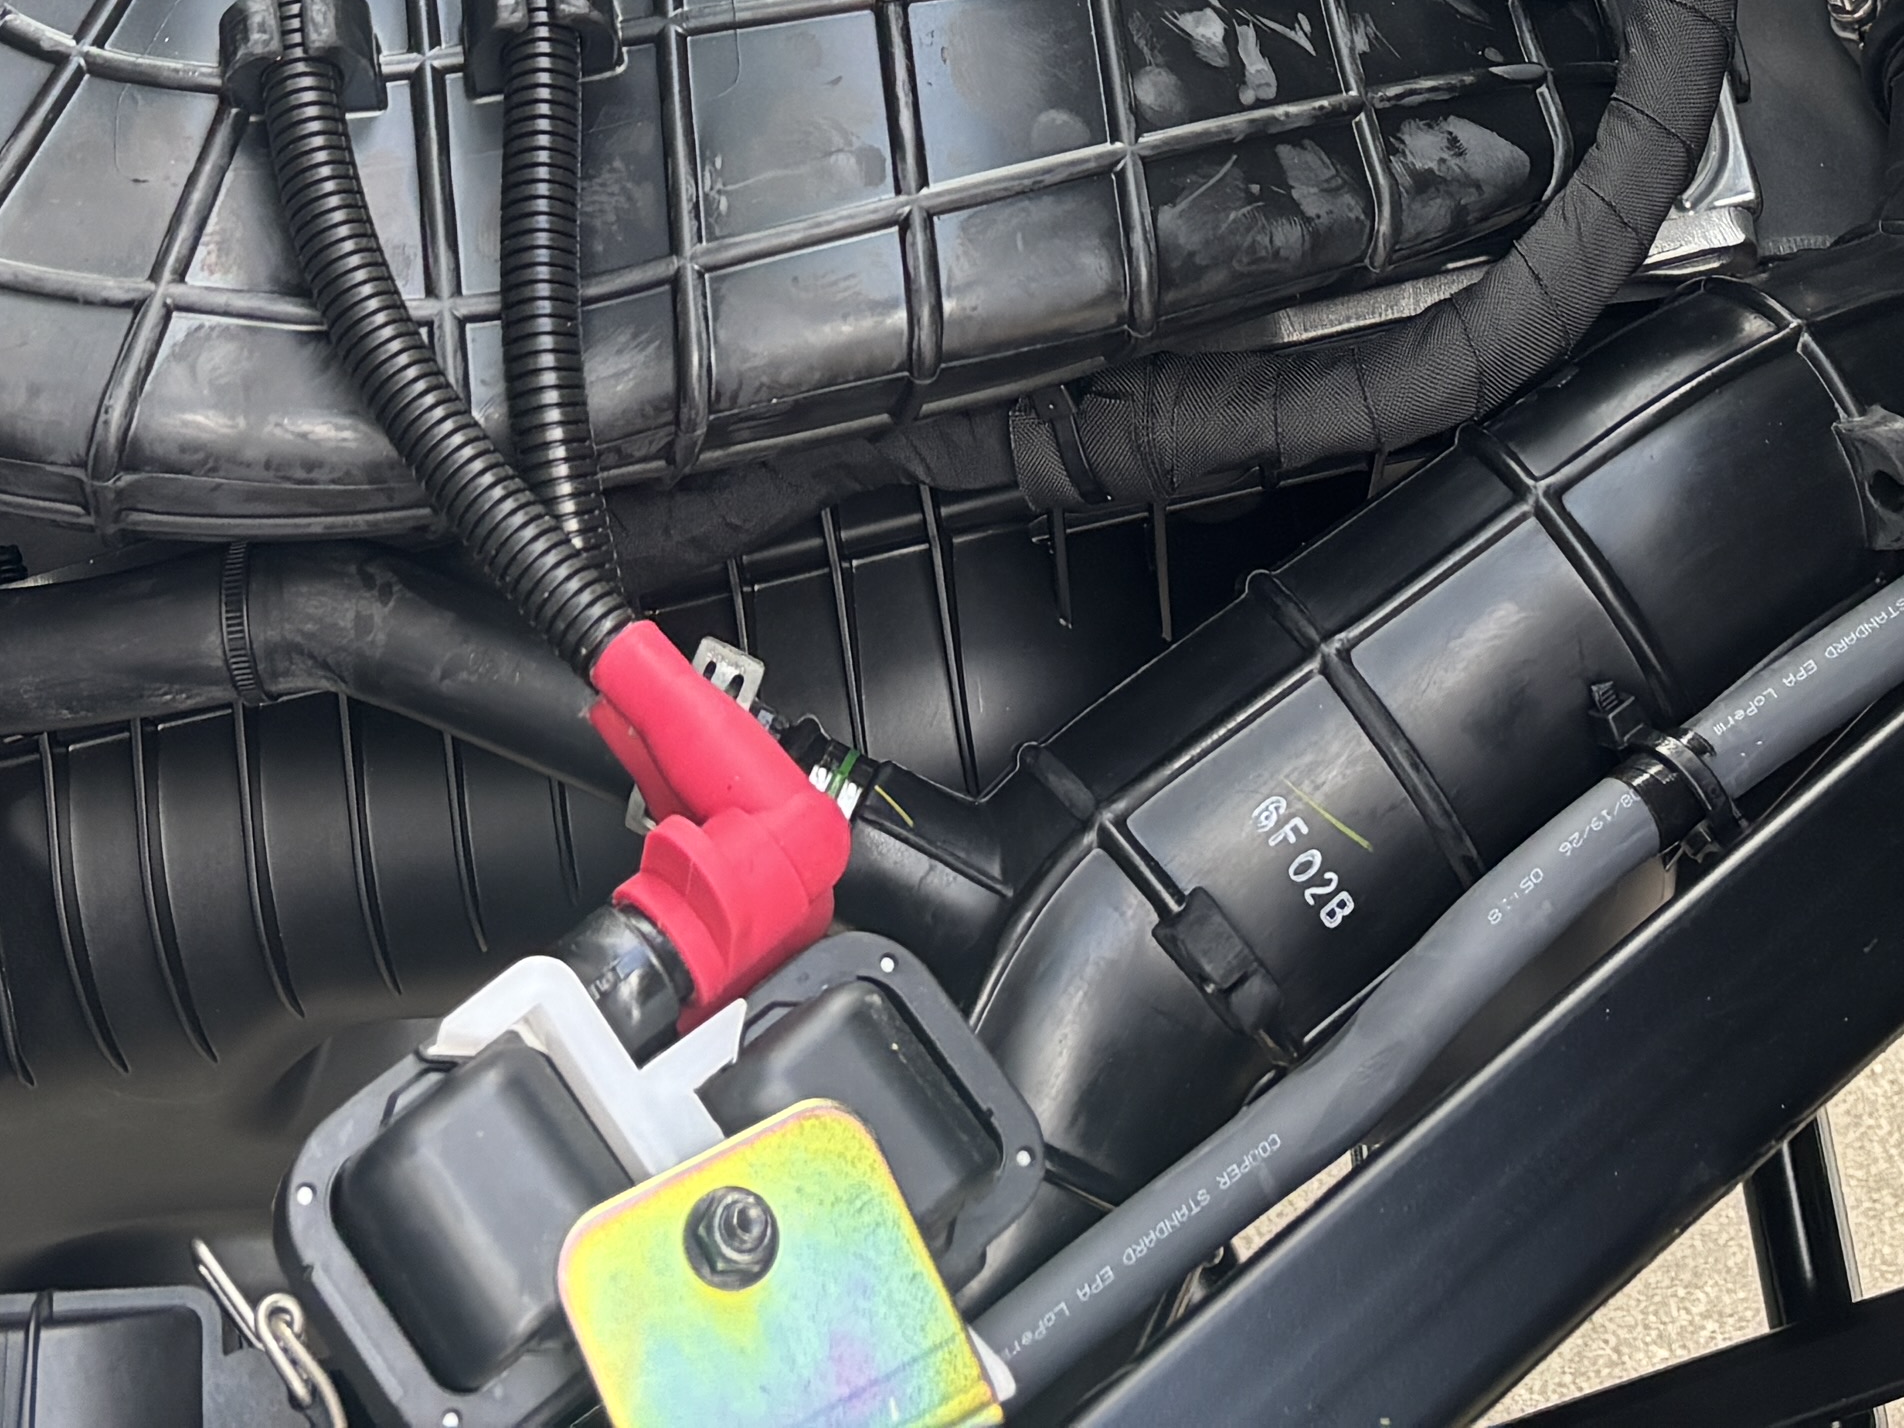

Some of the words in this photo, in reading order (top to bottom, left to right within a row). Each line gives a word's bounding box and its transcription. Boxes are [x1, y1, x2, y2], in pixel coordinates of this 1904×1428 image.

[1782, 659, 1818, 688] EPA
[1712, 687, 1778, 737] LoPerm
[1215, 1133, 1281, 1190] COOPER
[1122, 1188, 1211, 1266] STANDARD
[1076, 1265, 1115, 1302] EPA
